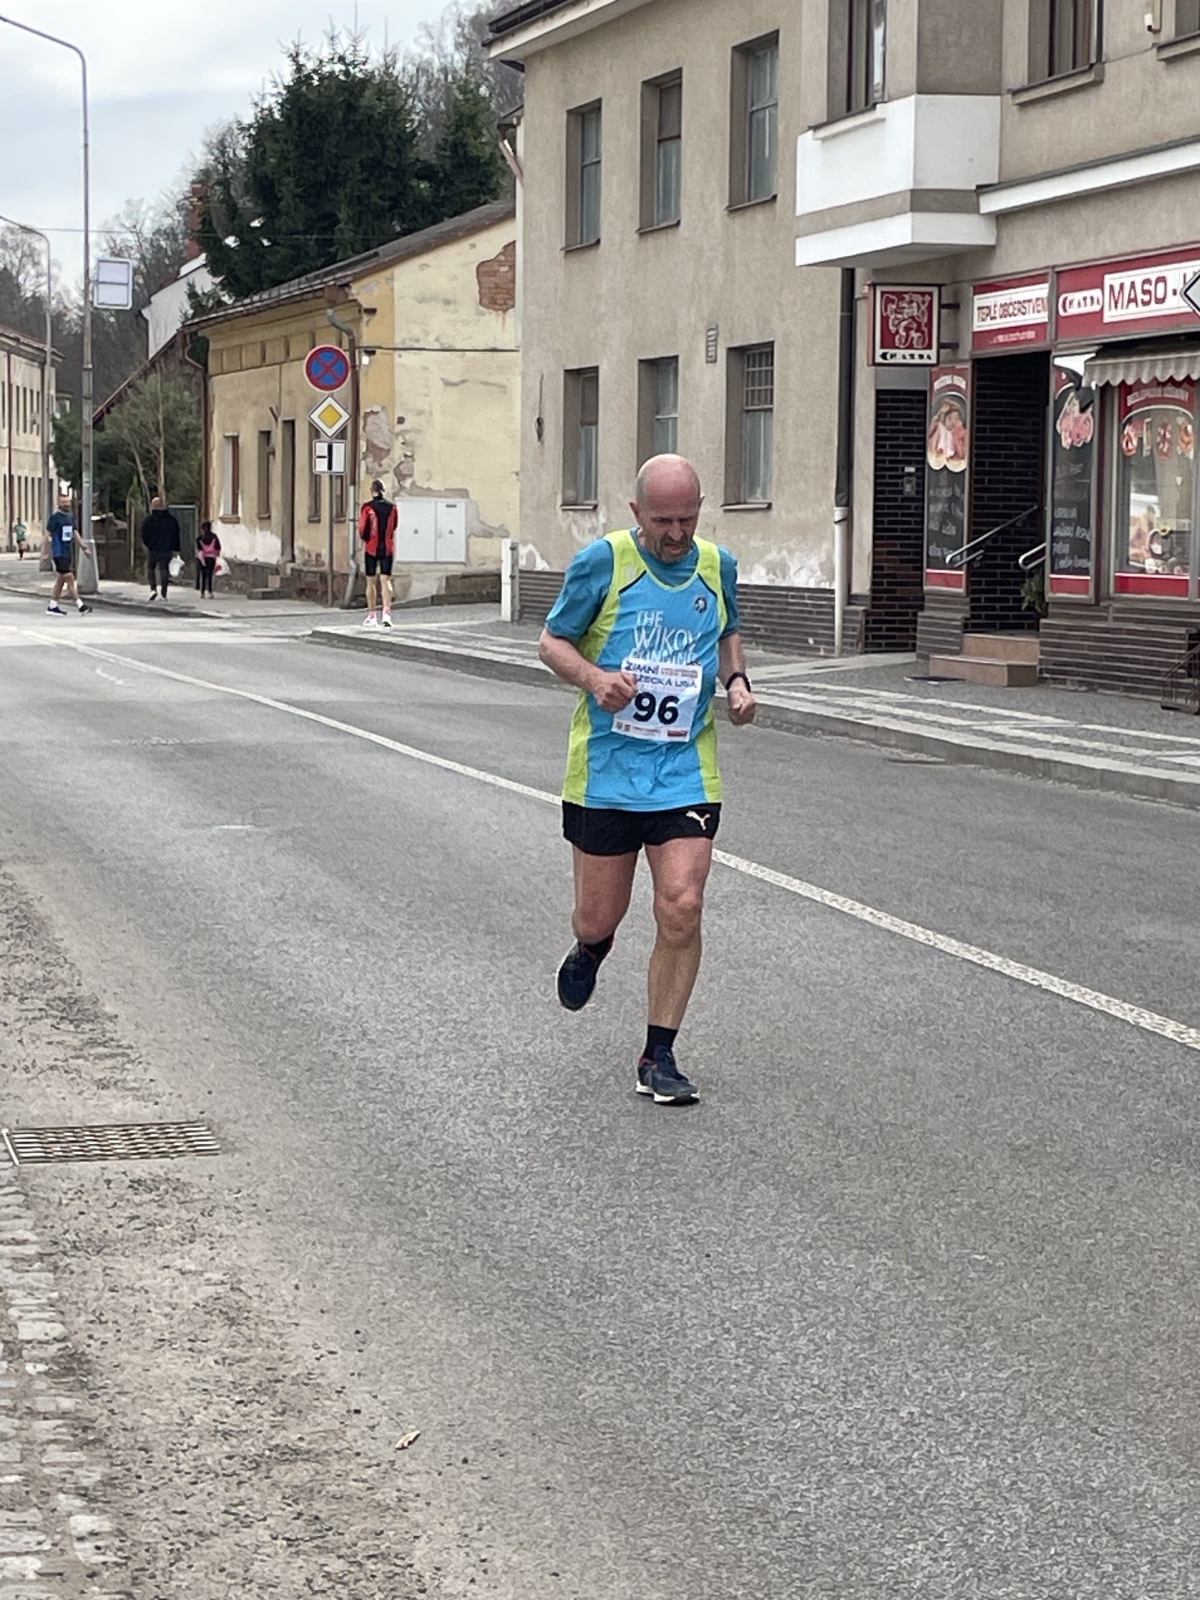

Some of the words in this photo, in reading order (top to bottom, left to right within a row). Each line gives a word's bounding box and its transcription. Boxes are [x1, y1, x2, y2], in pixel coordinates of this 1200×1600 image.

[1108, 275, 1168, 312] MASO
[636, 609, 664, 627] THE
[633, 692, 680, 725] 96
